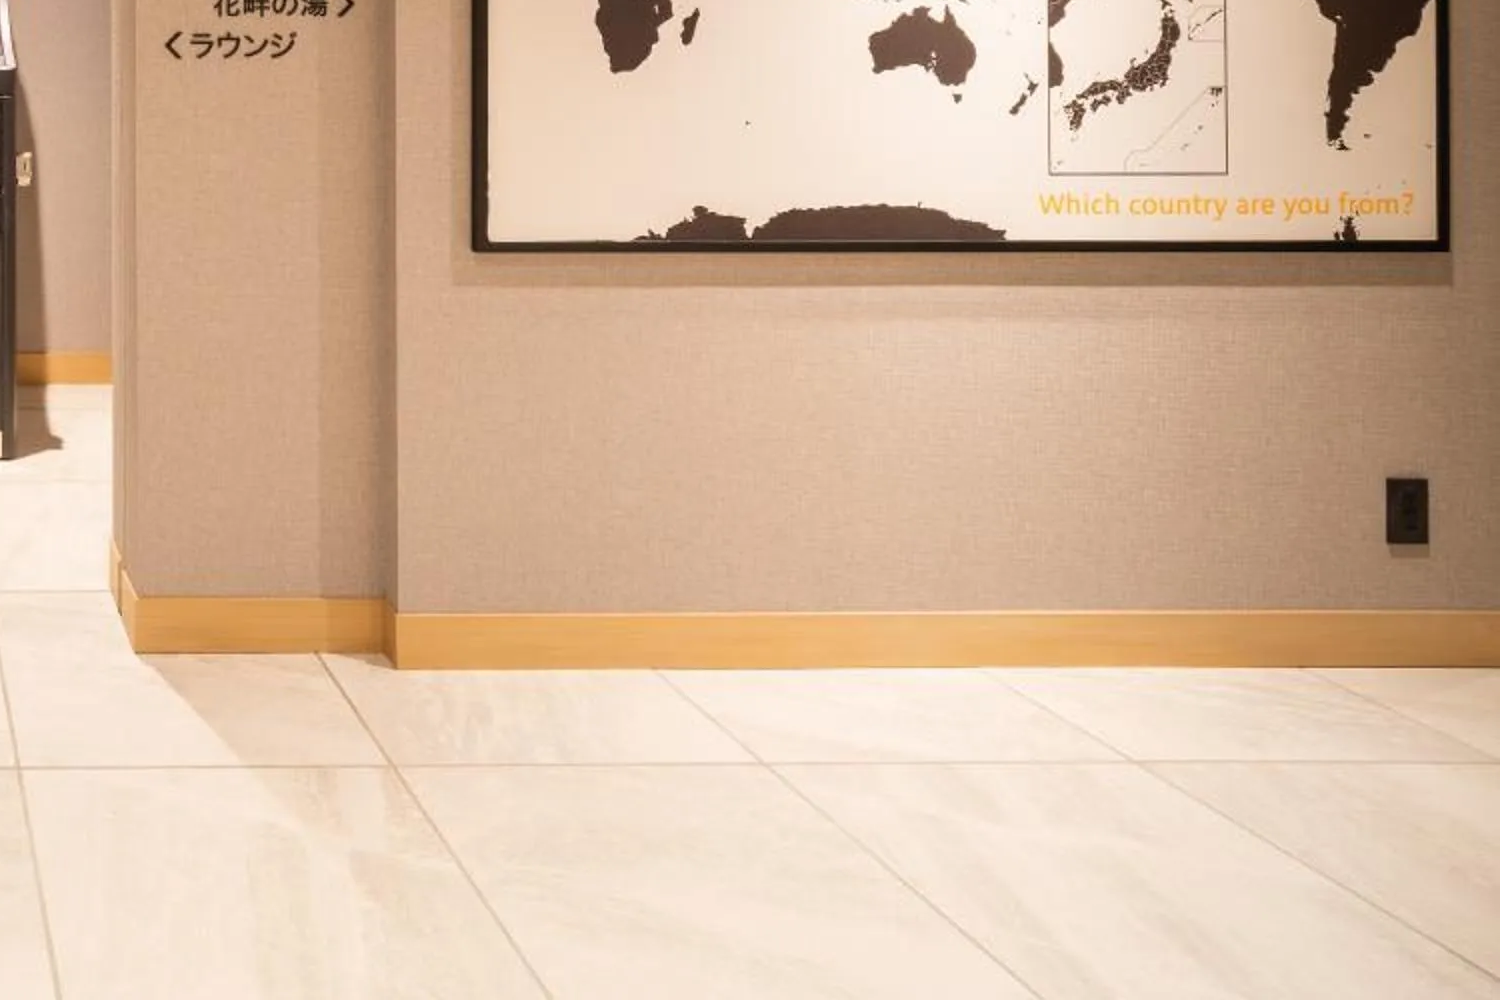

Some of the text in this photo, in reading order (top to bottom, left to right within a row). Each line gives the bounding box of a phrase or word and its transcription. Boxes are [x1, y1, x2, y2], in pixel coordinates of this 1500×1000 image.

[190, 31, 297, 59] ラウンジ
[1039, 191, 1414, 222] Which country are you from?
